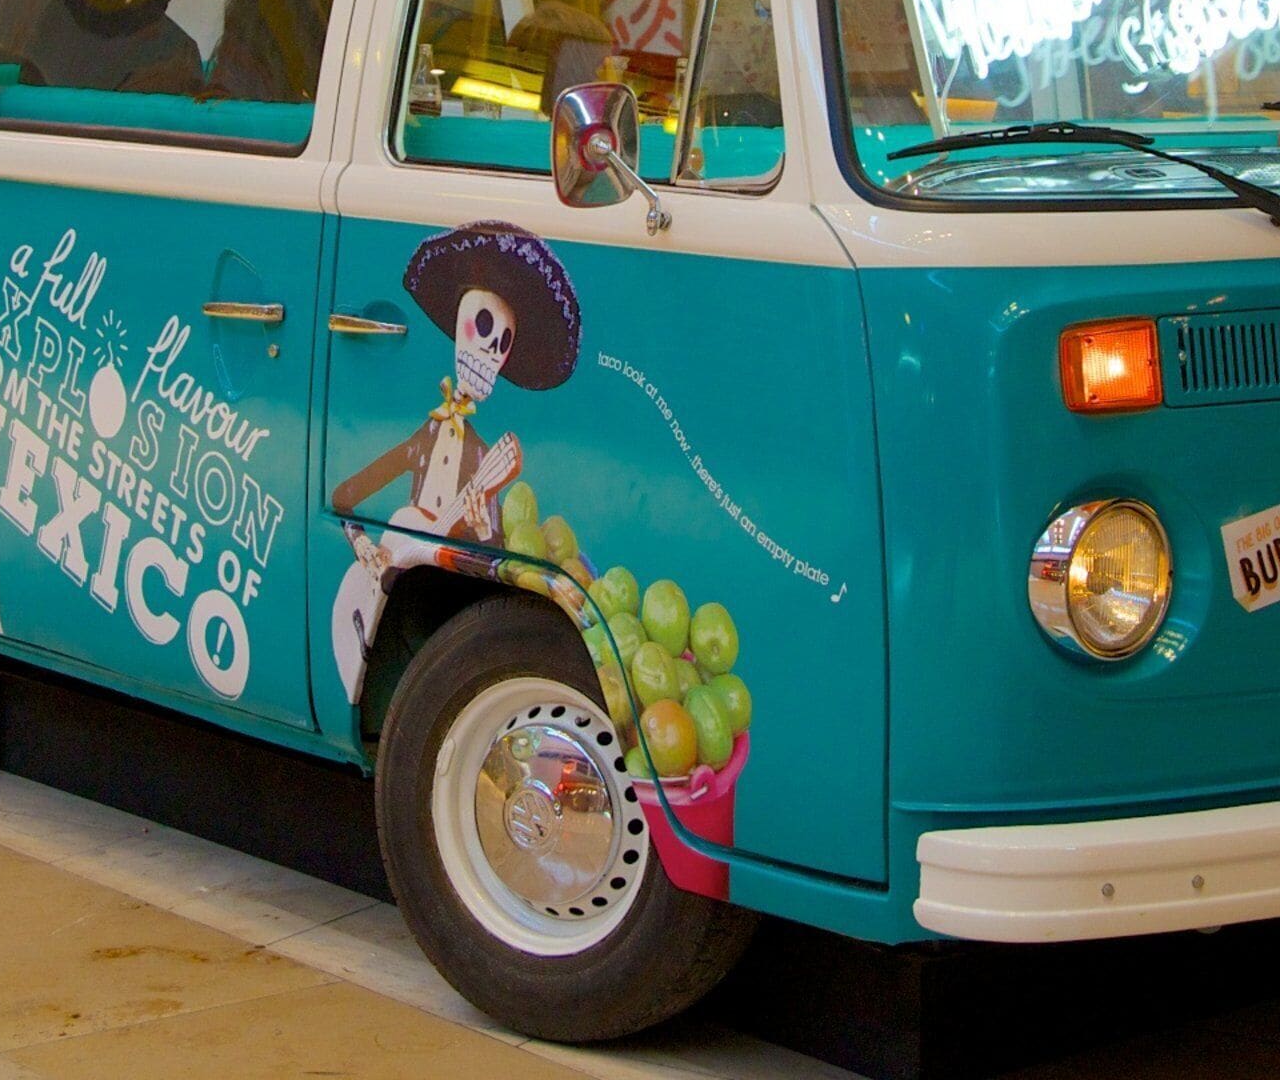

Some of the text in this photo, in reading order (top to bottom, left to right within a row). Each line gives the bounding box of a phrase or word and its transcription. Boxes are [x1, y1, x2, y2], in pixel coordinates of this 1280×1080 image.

[10, 228, 107, 329] a full
[131, 314, 269, 461] flavour
[38, 392, 83, 461] THE
[89, 440, 205, 564] STREETS
[218, 550, 261, 606] OF
[598, 351, 621, 371] taco
[622, 361, 646, 388] look
[645, 382, 658, 399] at
[655, 395, 672, 420] me
[720, 494, 741, 521] just
[740, 516, 756, 536] an
[756, 531, 795, 568] empty
[794, 560, 829, 586] plate
[1256, 522, 1272, 542] BIG
